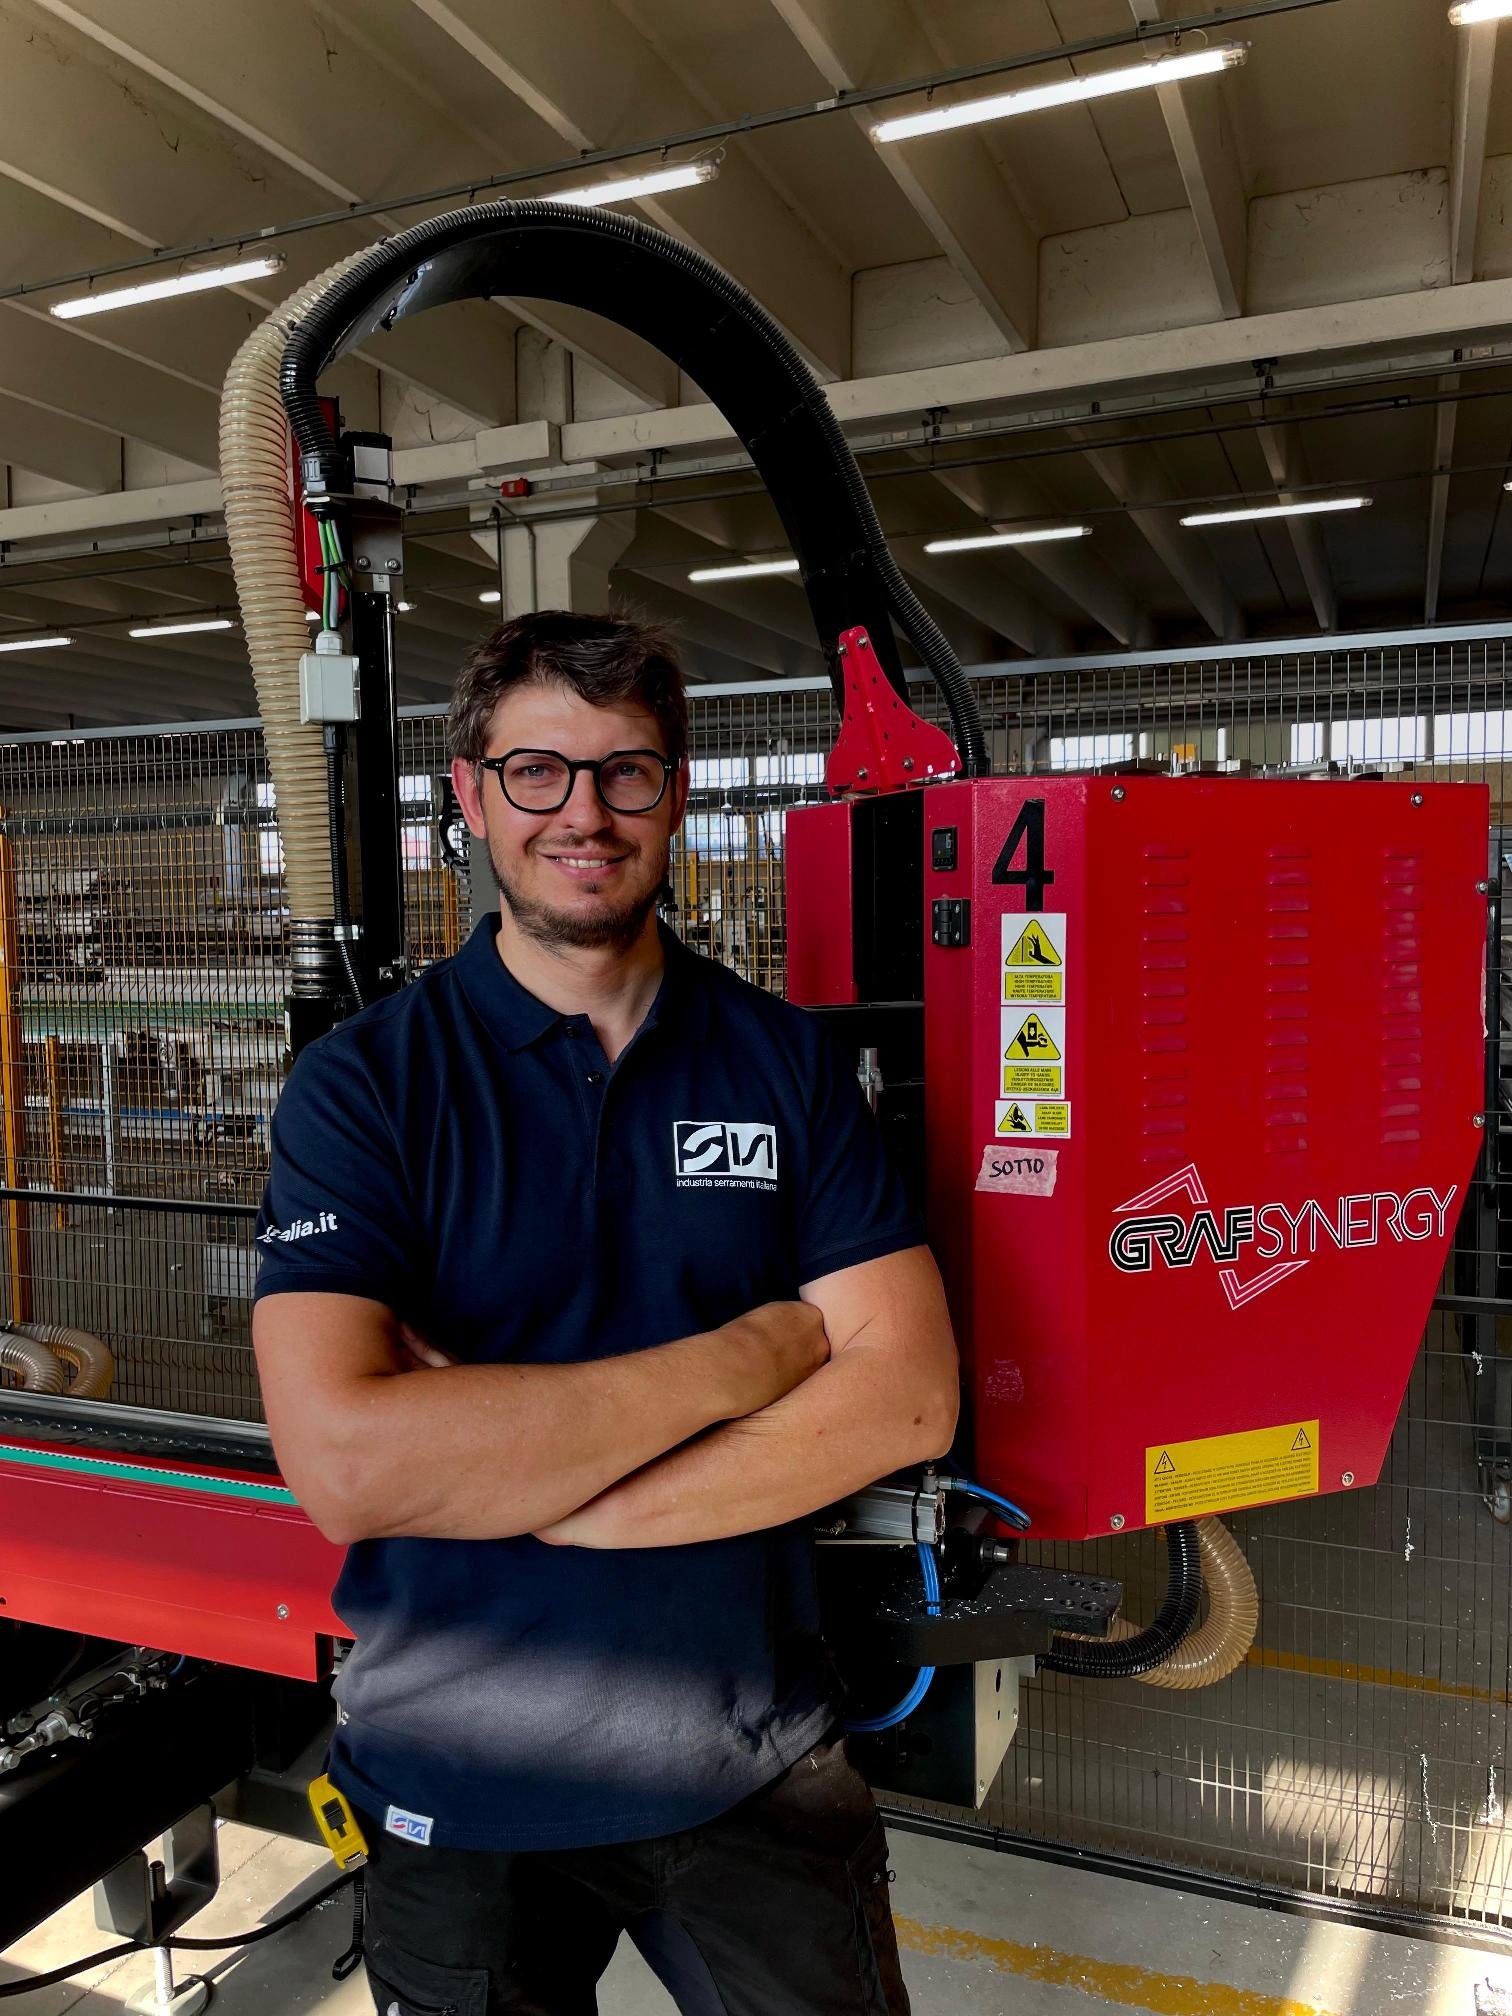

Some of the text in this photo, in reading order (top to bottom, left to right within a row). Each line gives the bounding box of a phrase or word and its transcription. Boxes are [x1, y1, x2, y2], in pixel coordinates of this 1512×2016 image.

[992, 799, 1055, 912] 4
[989, 1158, 1045, 1178] SOTTO
[676, 1177, 713, 1188] industria
[714, 1179, 756, 1189] serramenti
